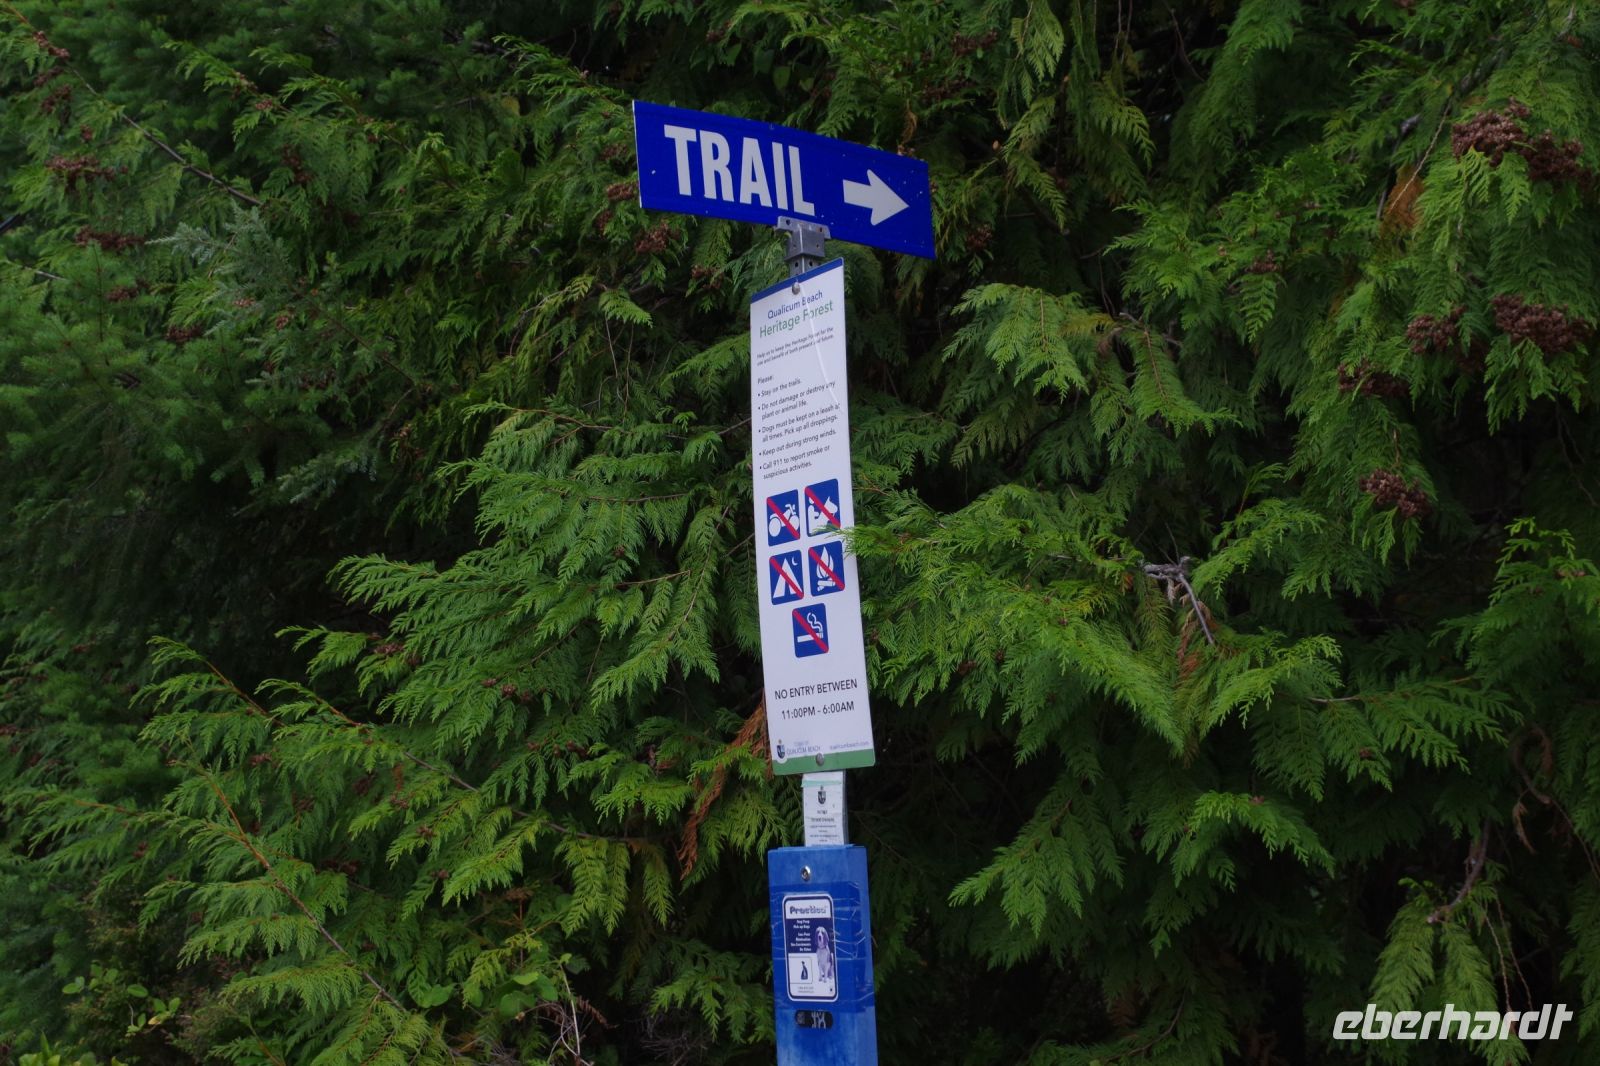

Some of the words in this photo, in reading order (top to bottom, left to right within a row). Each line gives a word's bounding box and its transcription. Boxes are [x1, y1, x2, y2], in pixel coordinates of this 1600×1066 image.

[664, 124, 815, 216] TRAIL
[768, 301, 800, 319] Qualicum
[802, 290, 822, 306] Beach
[760, 316, 800, 338] Heritage
[803, 300, 833, 321] Forest
[779, 394, 798, 404] damage
[806, 384, 824, 395] destroy
[762, 410, 774, 421] plant
[782, 401, 798, 413] animal
[762, 424, 774, 433] Dogs
[776, 420, 788, 429] must
[796, 414, 807, 422] kept
[820, 404, 834, 414] leash
[785, 426, 794, 435] Pick
[796, 425, 802, 433] up
[762, 448, 776, 456] Keep
[786, 439, 802, 450] during
[803, 434, 818, 444] strong
[763, 461, 772, 470] Call
[774, 458, 782, 466] 911
[790, 452, 806, 463] report
[806, 446, 823, 458] smoke
[764, 468, 788, 480] suspicious
[774, 689, 788, 700] NO
[790, 685, 815, 698] ENTRY
[817, 678, 858, 694] BETWEEN
[782, 706, 816, 720] 11:00PM
[822, 700, 854, 714] 6:00AM
